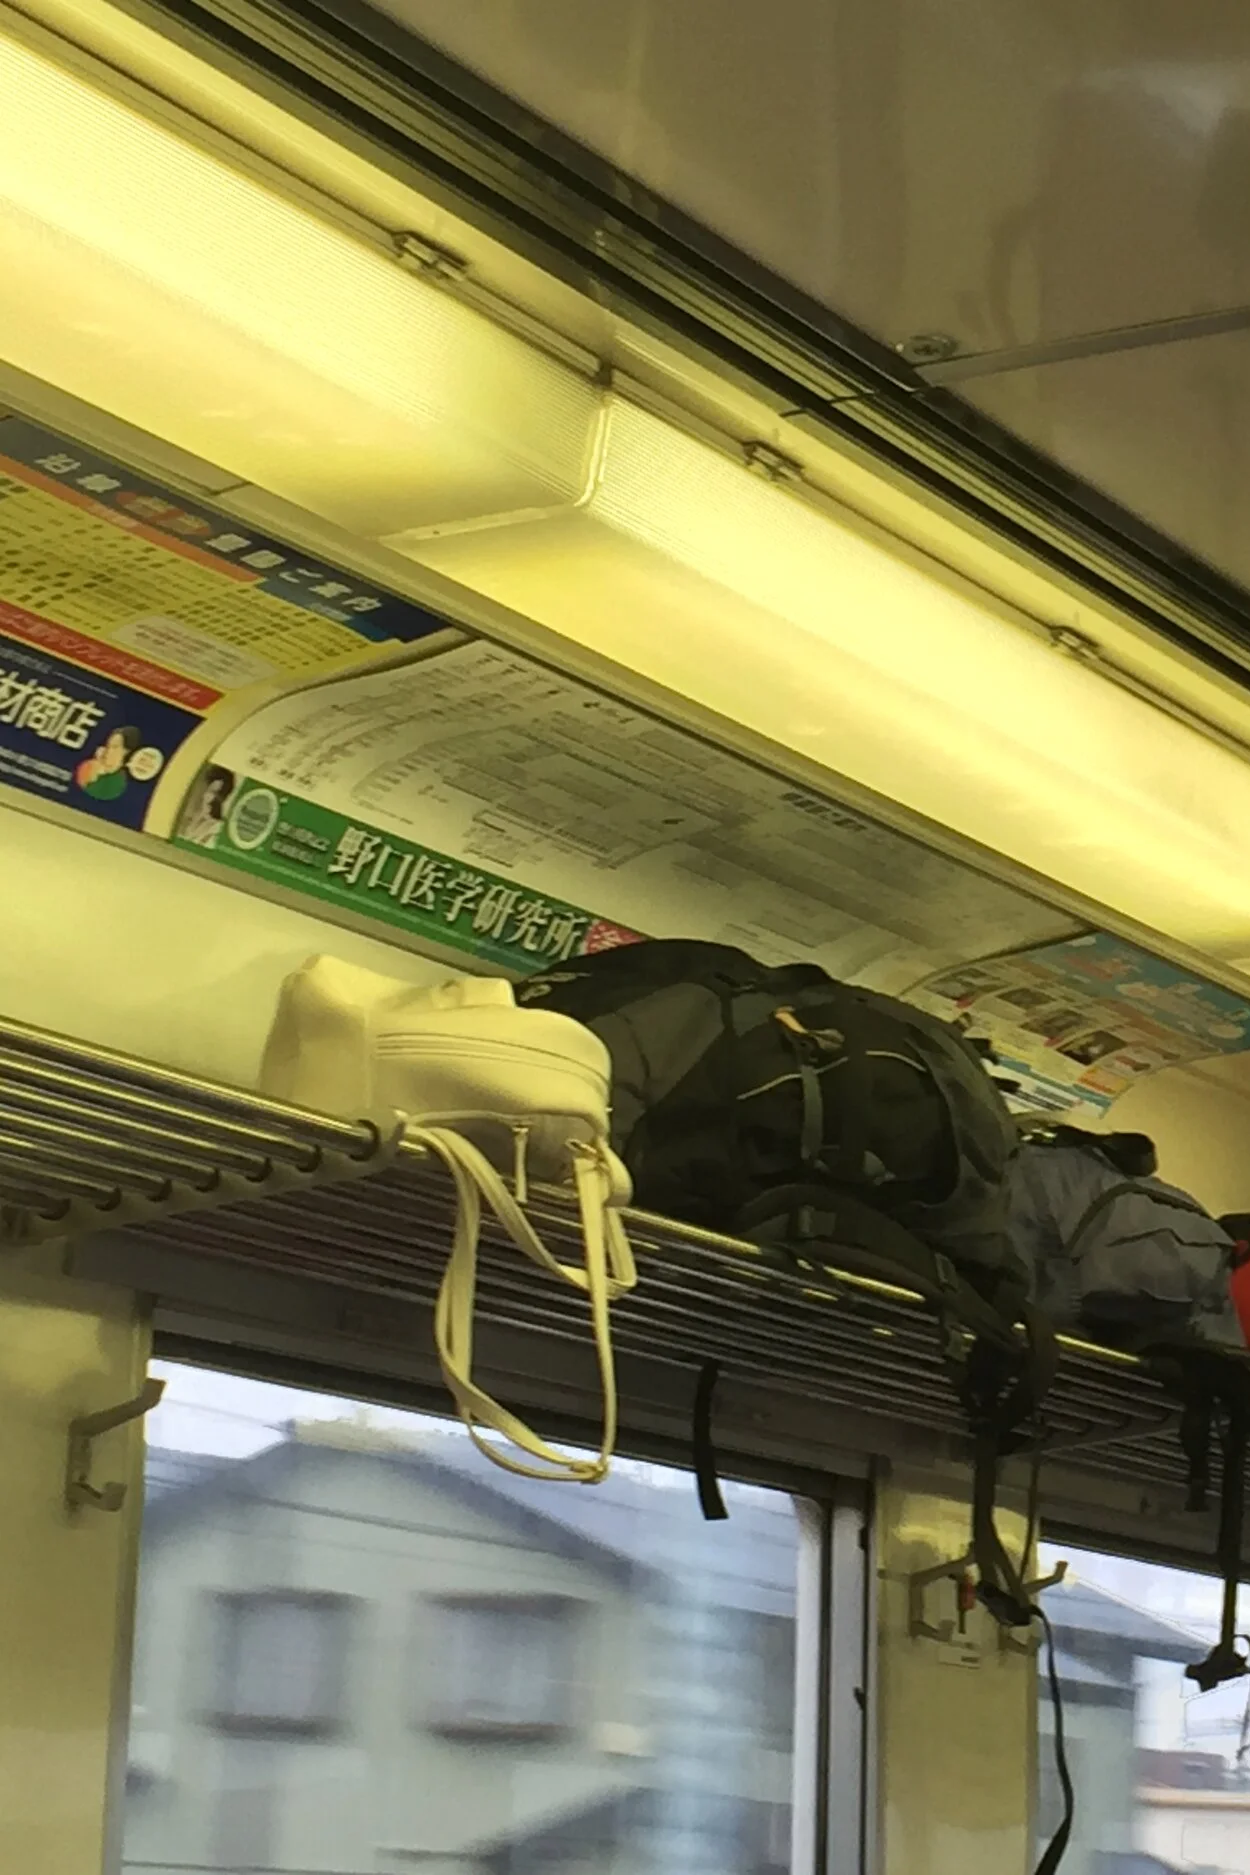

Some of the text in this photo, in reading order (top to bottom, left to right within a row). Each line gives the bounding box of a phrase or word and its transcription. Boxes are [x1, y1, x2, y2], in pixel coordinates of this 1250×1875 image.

[328, 826, 588, 961] 野口医学研究所
